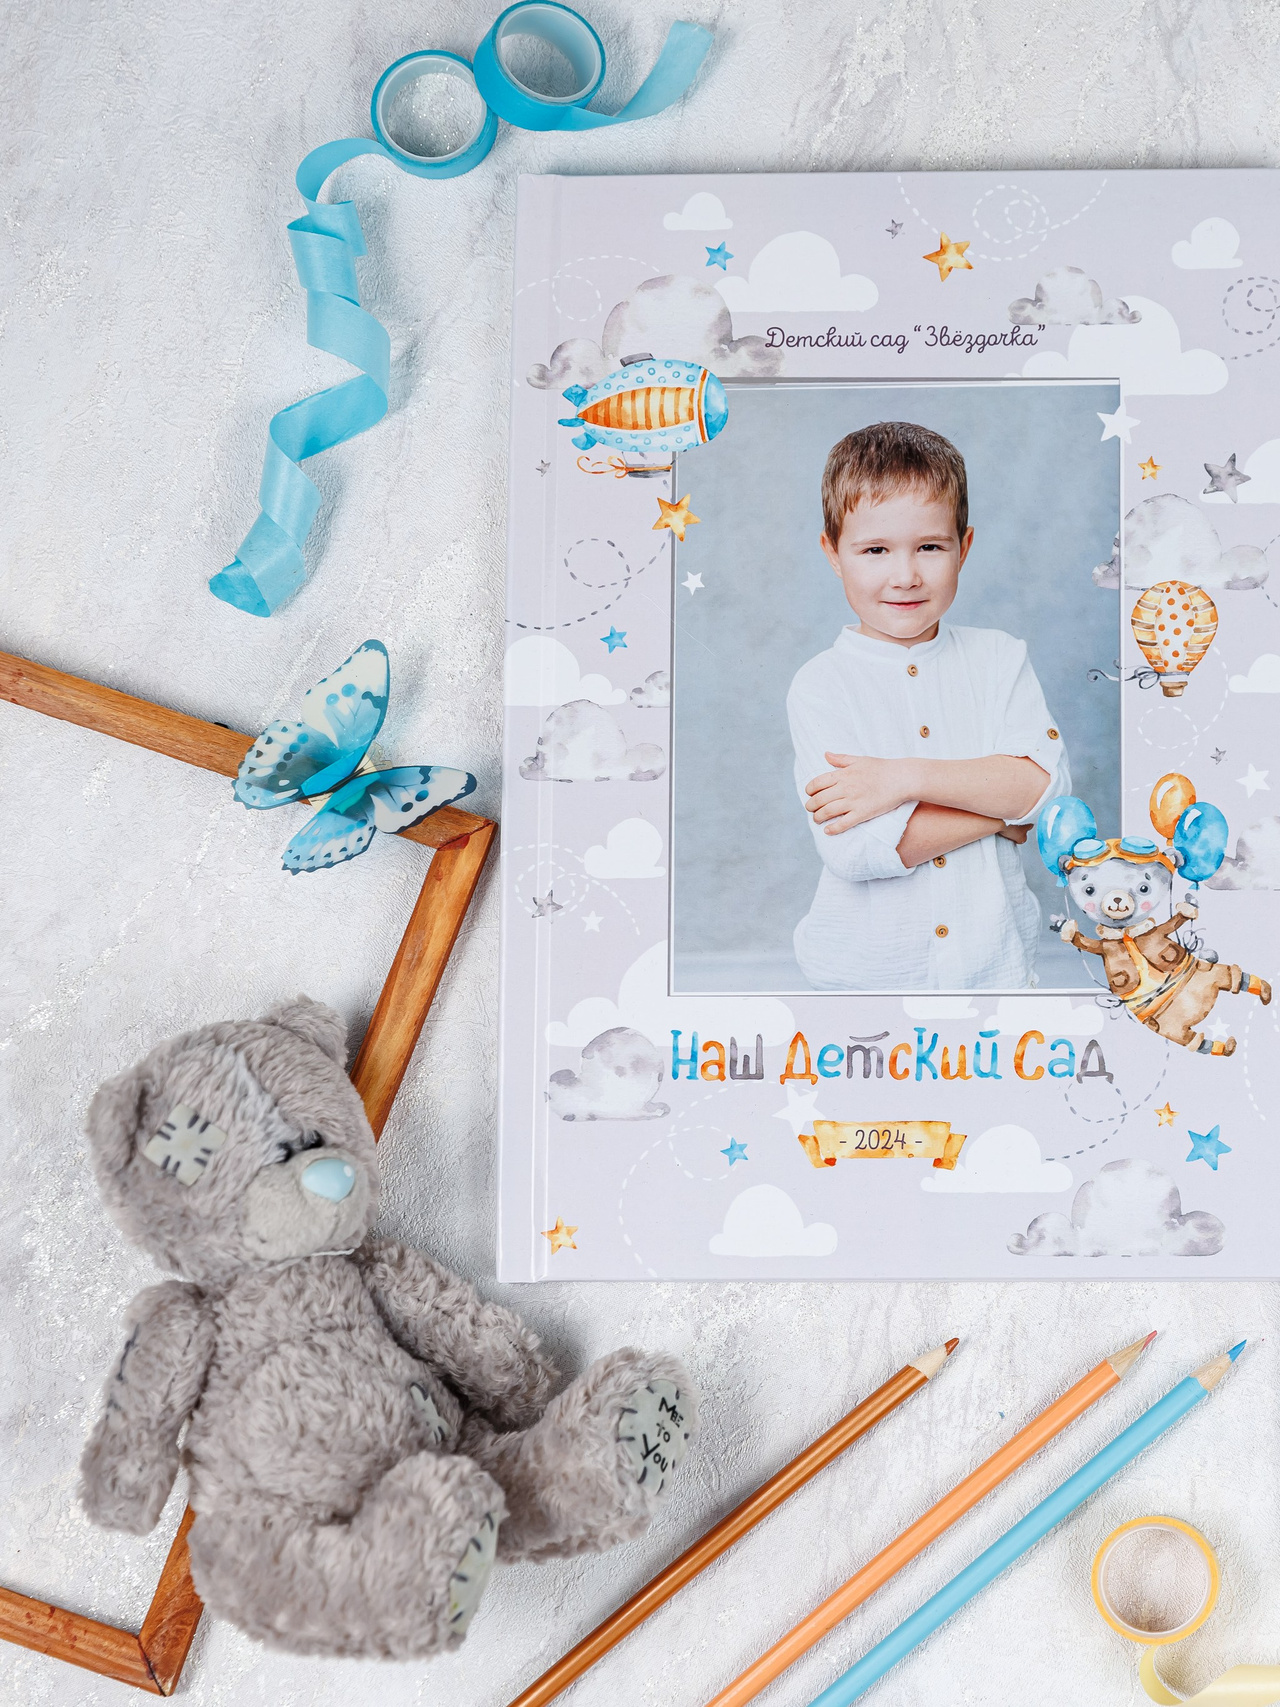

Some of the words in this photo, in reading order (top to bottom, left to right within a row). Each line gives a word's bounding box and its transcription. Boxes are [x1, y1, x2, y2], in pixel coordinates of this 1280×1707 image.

[764, 326, 868, 348] Детский
[870, 334, 910, 355] сад
[670, 1029, 765, 1083] Наш
[779, 1026, 1003, 1086] Детский
[1013, 1029, 1114, 1085] Сад
